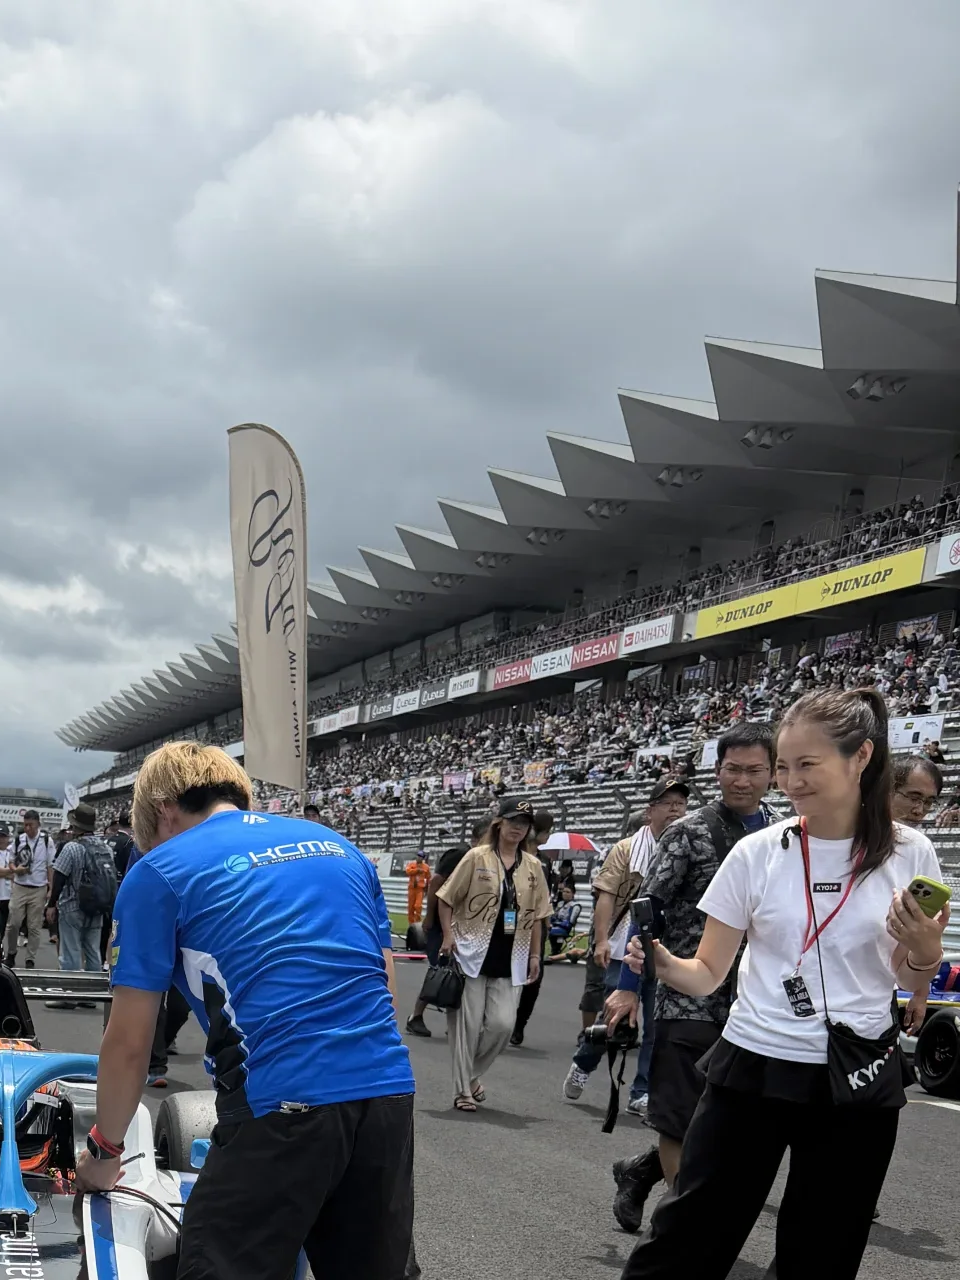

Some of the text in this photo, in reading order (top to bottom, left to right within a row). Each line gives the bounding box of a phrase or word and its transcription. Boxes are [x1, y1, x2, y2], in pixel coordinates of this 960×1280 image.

[831, 568, 894, 596] DUNLOP
[724, 601, 774, 623] DUNLOP
[634, 623, 671, 645] DAIHATSU
[532, 653, 571, 673] NISSAN
[573, 640, 618, 664] NISSAN
[494, 663, 531, 684] NISSAN
[248, 840, 345, 863] KCMG
